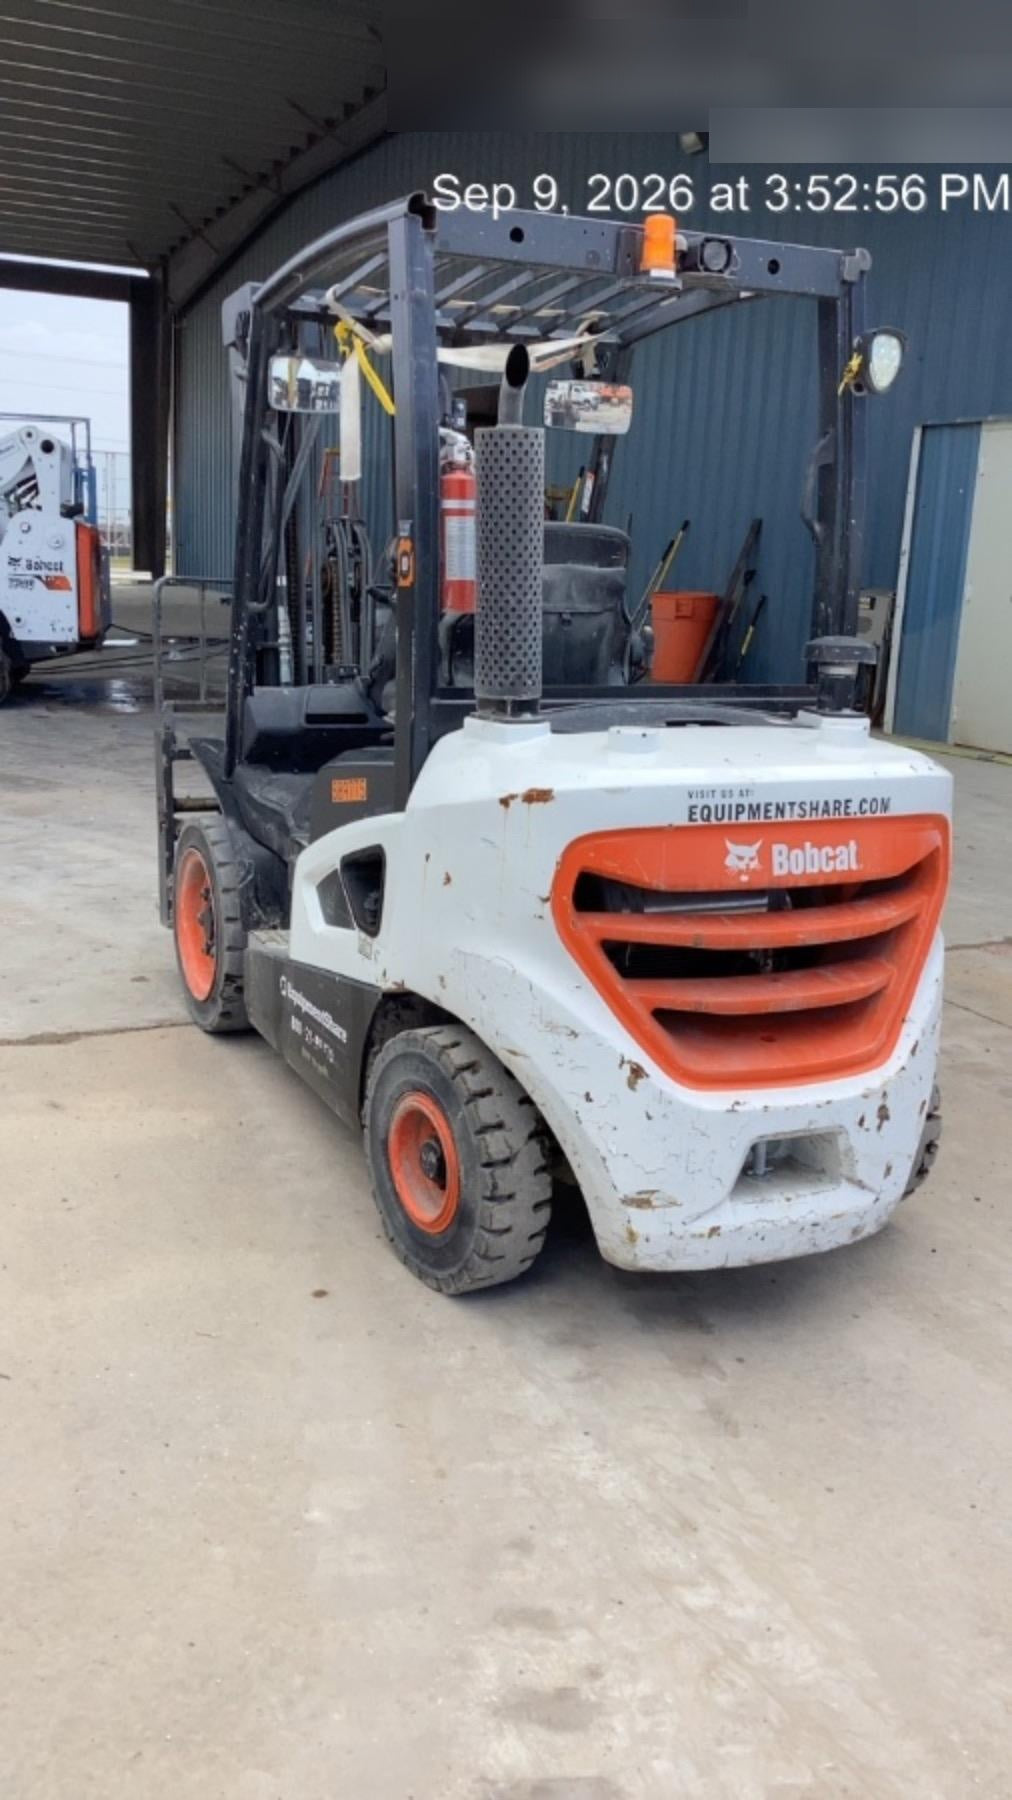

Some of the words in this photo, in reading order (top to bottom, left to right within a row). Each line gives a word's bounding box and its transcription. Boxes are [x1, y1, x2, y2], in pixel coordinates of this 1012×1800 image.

[688, 789, 716, 799] VISIT
[688, 797, 891, 822] EQUIPMENTSHARE.COM
[771, 840, 857, 877] Bobcat
